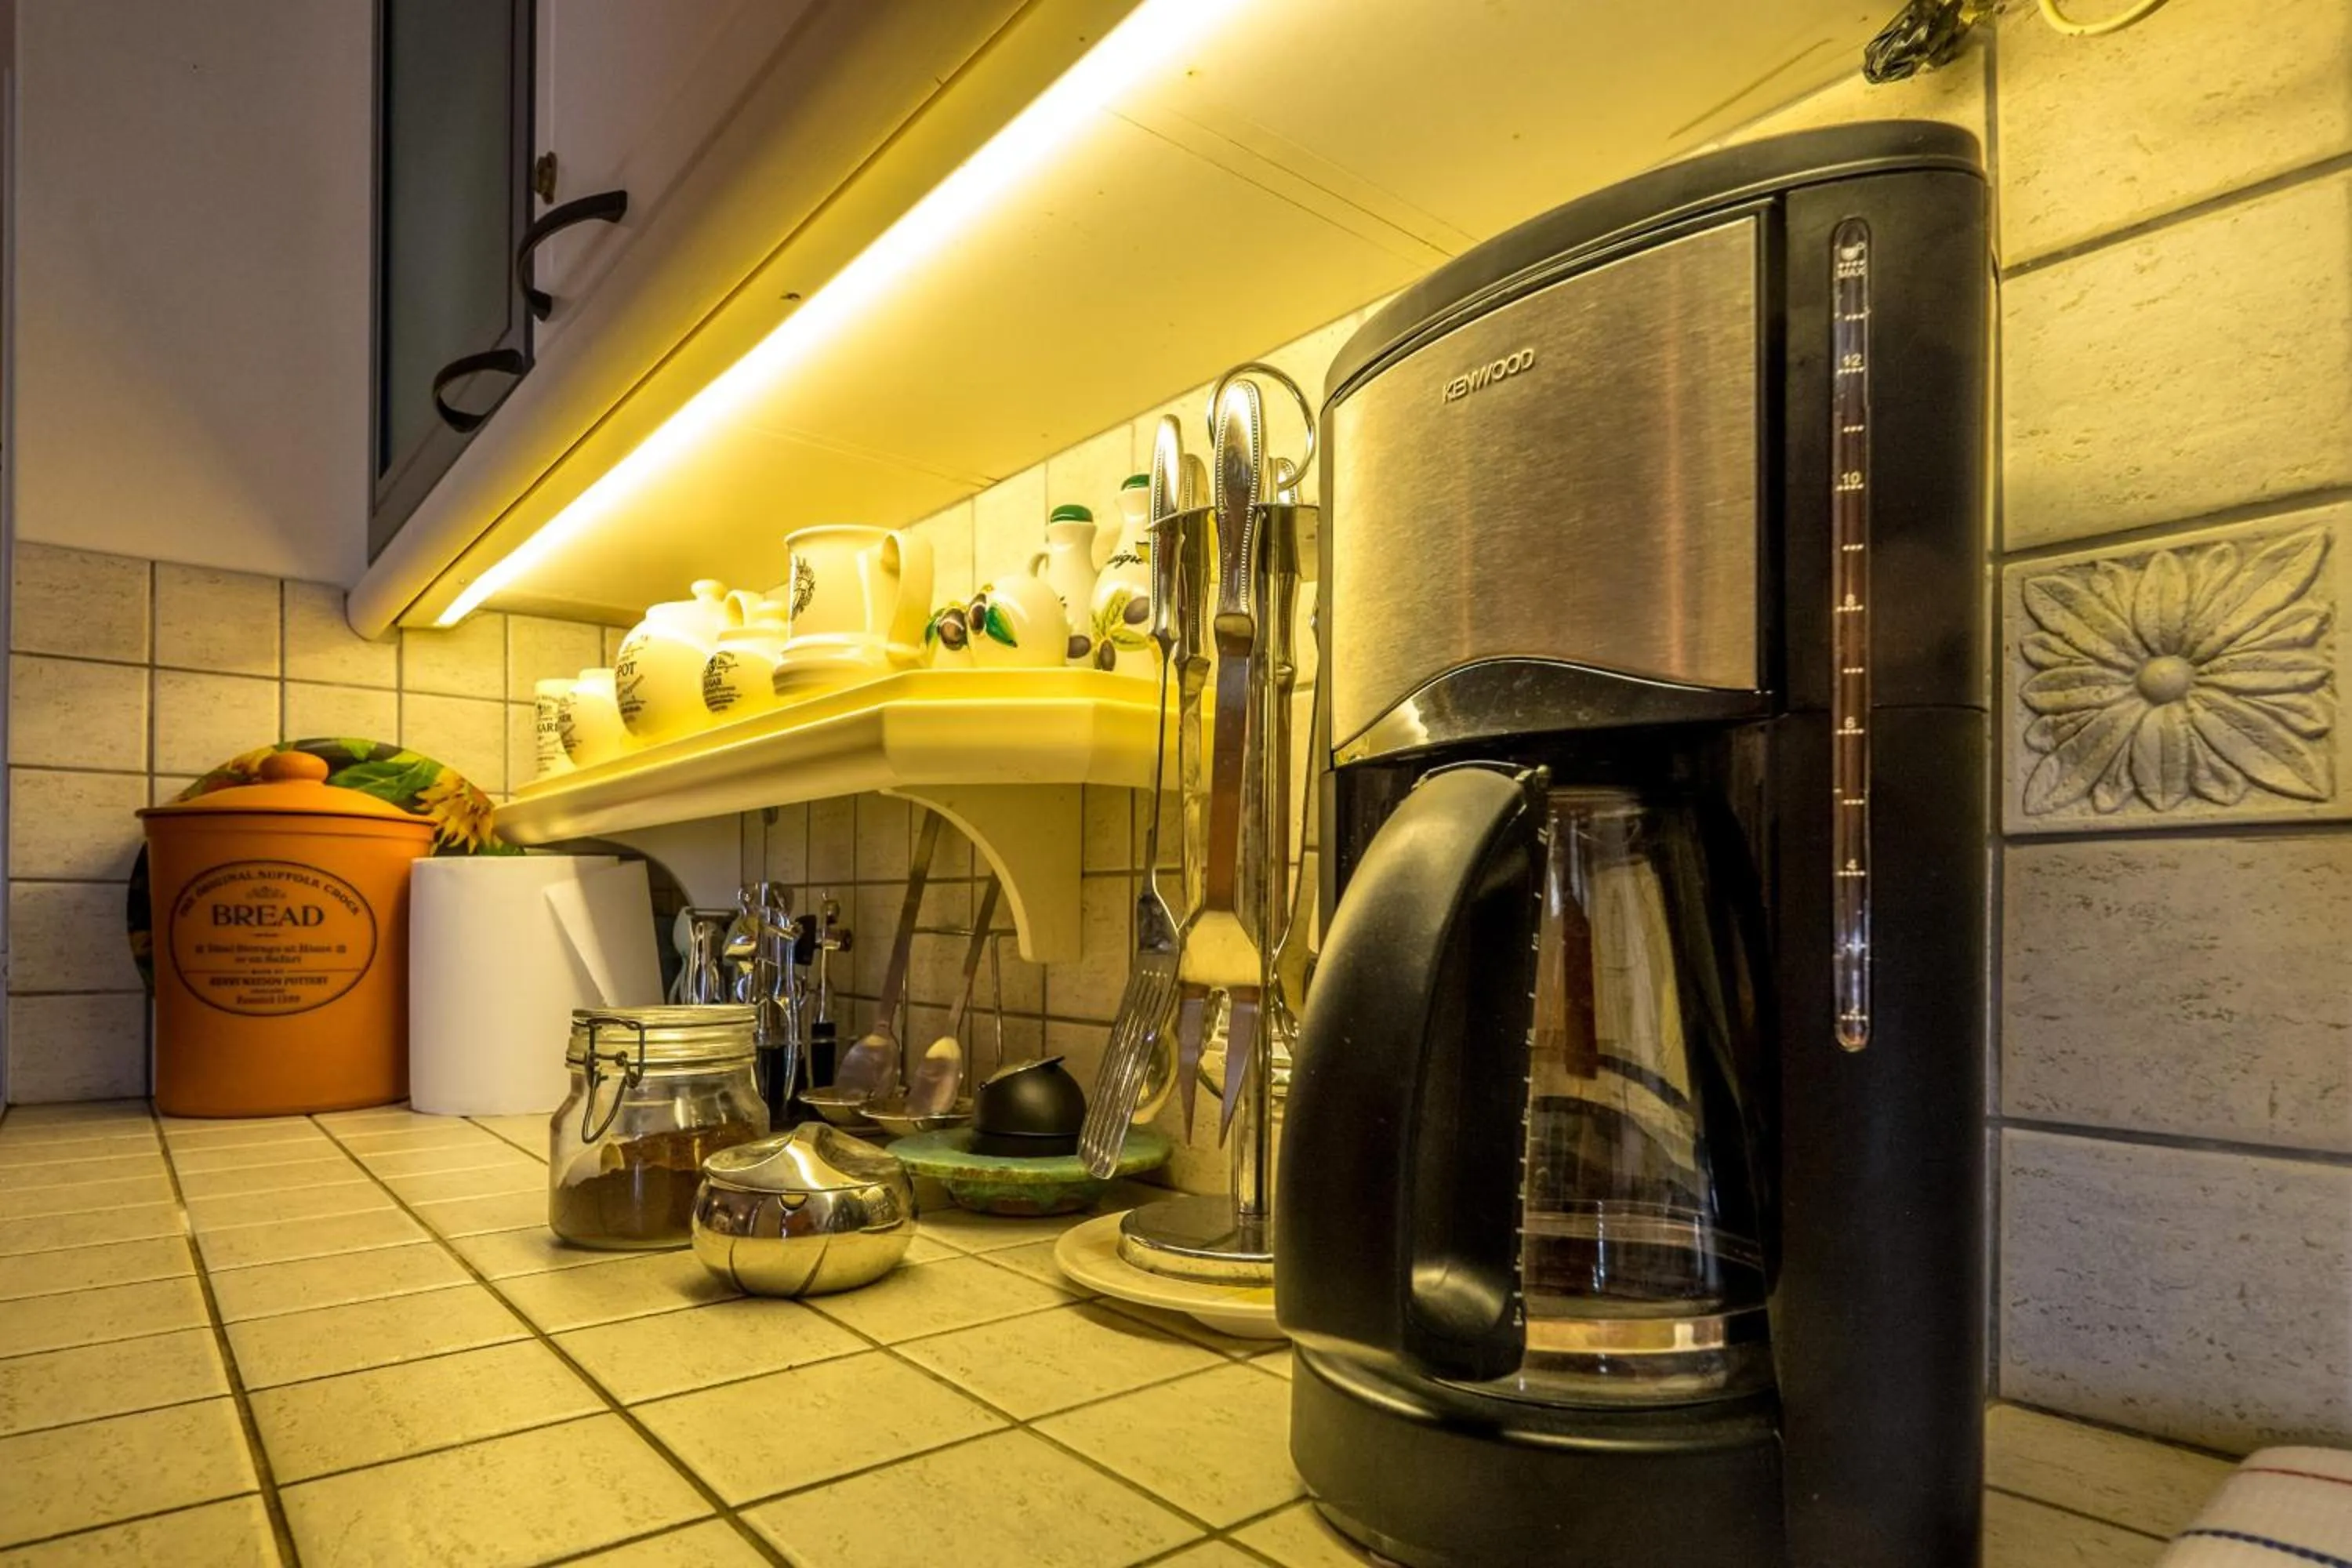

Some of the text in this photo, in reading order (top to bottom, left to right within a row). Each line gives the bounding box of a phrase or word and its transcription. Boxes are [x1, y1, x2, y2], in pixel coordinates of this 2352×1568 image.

[1838, 267, 1866, 278] MAX
[1843, 353, 1862, 366] 12
[1442, 348, 1534, 405] KENWOOD
[1842, 470, 1861, 485] 10
[1845, 716, 1856, 729] 6
[1846, 858, 1857, 871] 4
[196, 869, 252, 898] ORIGINAL
[257, 869, 320, 889] SUFFOLK
[212, 903, 325, 927] BREAD
